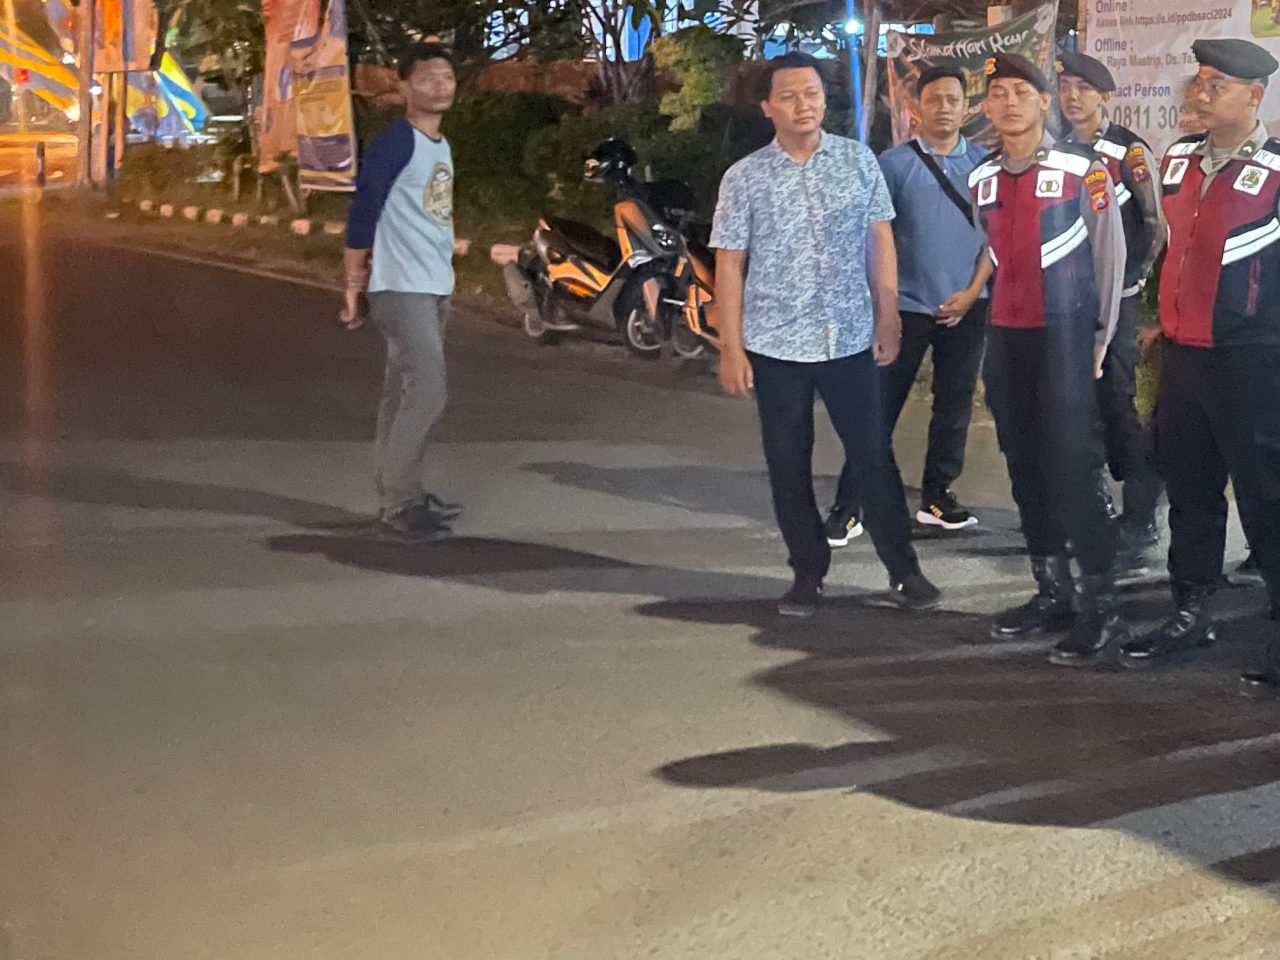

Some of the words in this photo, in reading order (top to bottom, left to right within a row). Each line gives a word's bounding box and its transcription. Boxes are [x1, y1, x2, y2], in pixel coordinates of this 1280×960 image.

[1095, 0, 1128, 14] Online
[1094, 38, 1128, 53] Offline
[1134, 83, 1171, 97] Person
[1112, 105, 1151, 129] 0811
